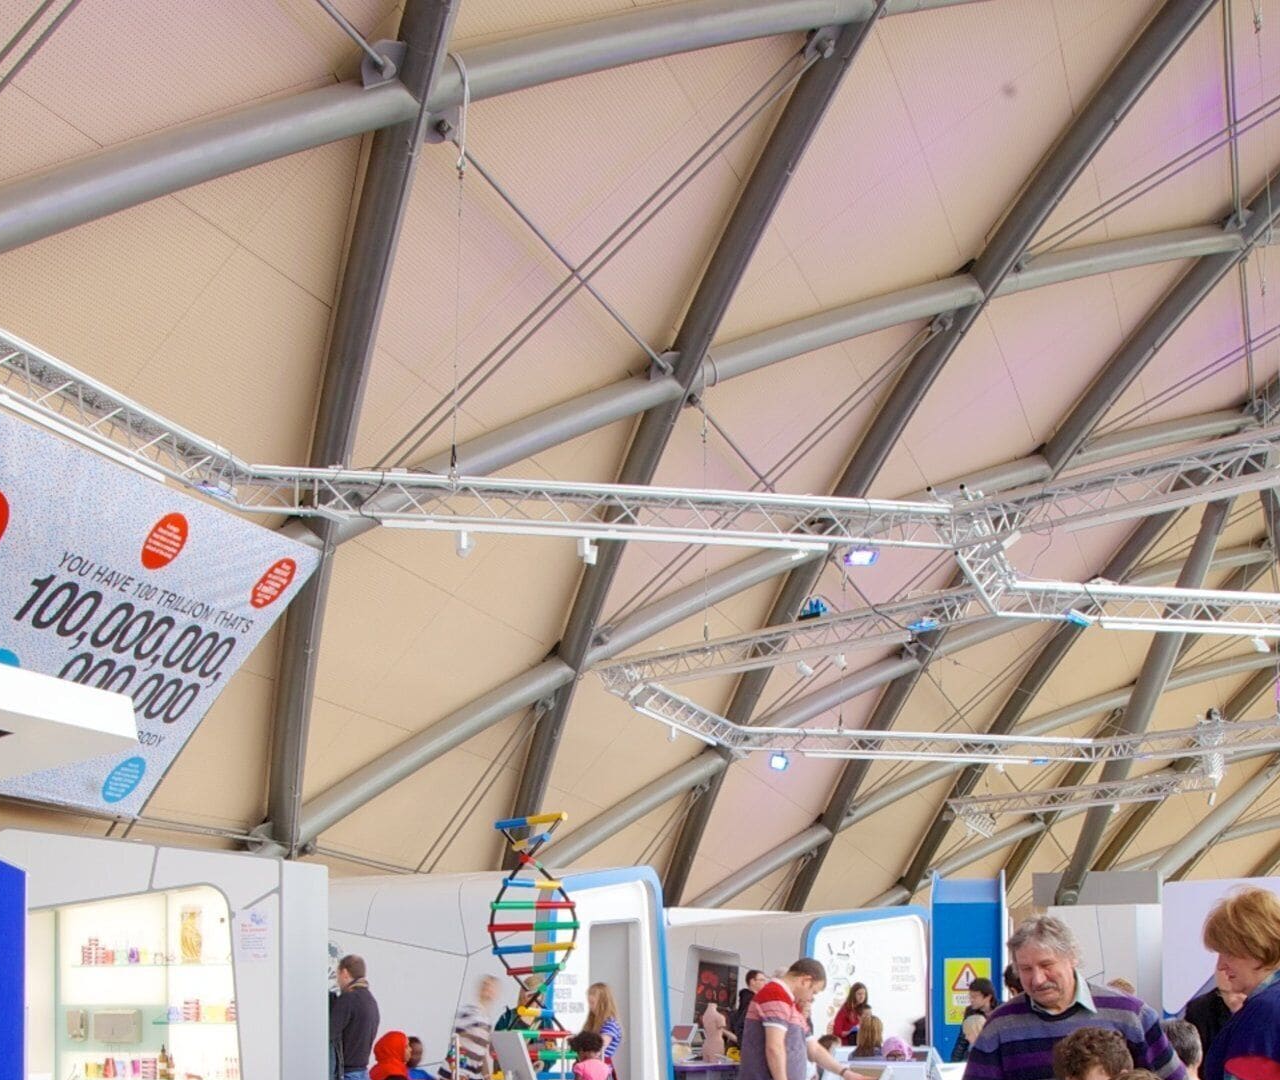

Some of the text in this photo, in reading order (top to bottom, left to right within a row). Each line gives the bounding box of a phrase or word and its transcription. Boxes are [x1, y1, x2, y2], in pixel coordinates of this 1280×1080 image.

[57, 552, 94, 577] YOU
[91, 563, 134, 592] HAVE
[133, 582, 158, 601] 100
[158, 590, 214, 619] TRILLION
[14, 574, 236, 689] 100,000,000,
